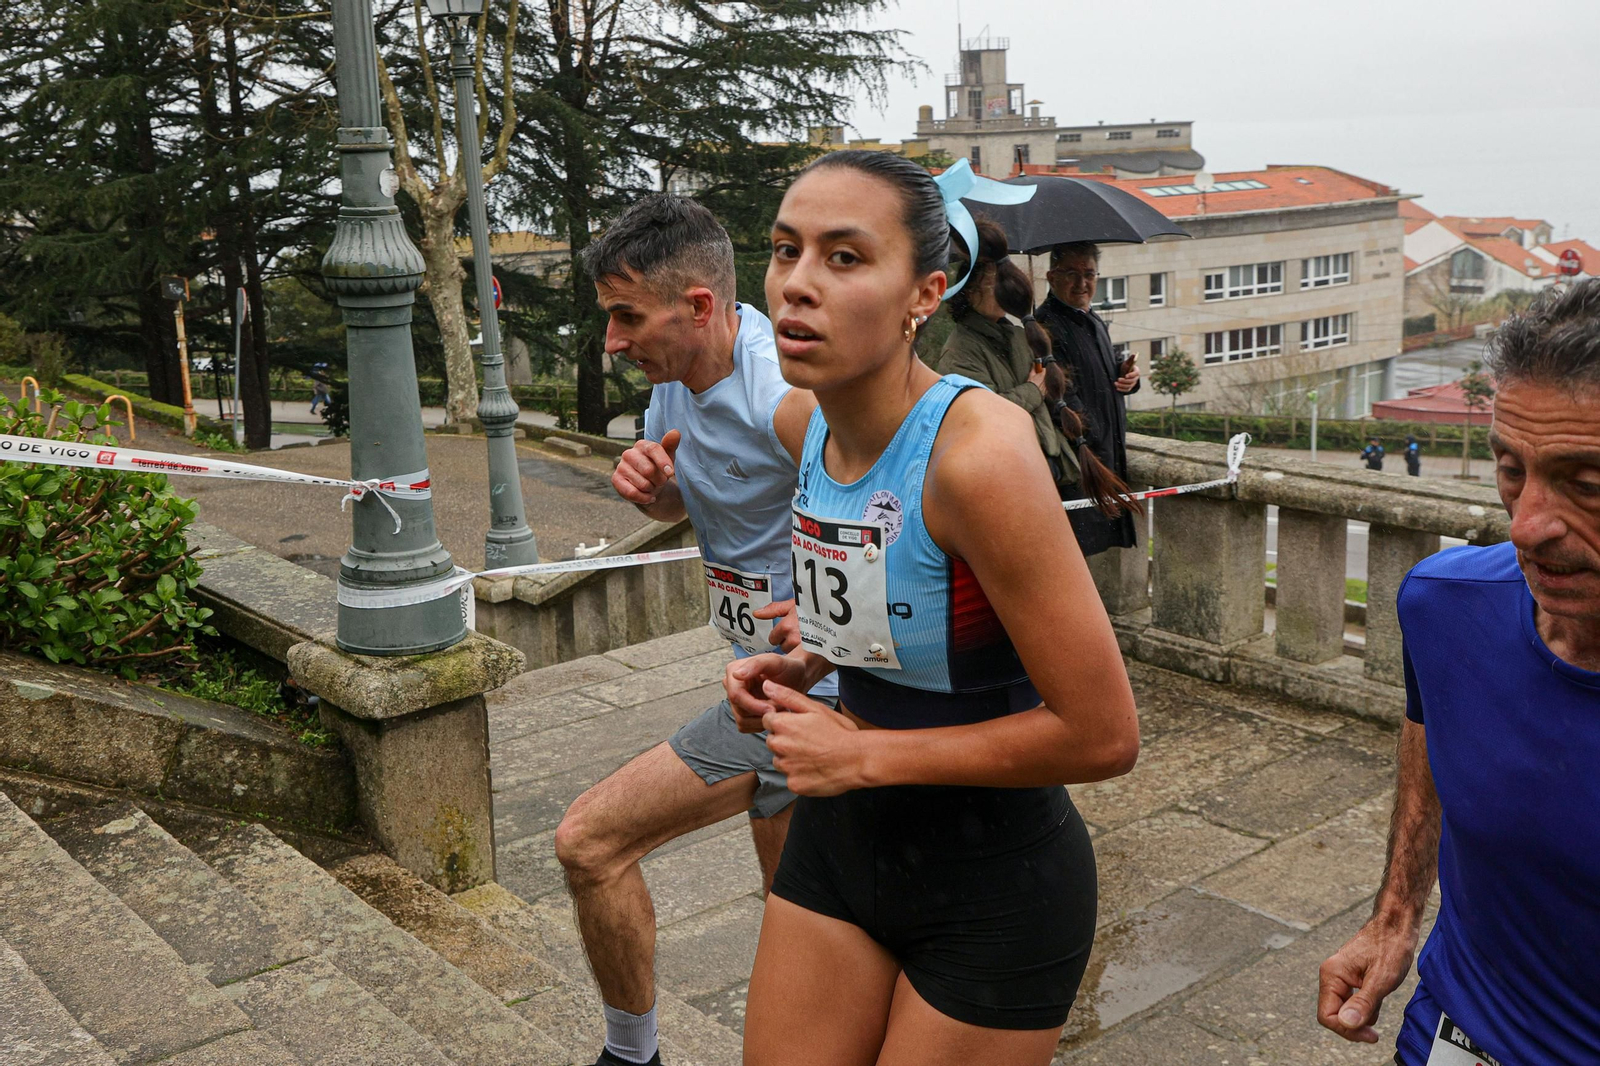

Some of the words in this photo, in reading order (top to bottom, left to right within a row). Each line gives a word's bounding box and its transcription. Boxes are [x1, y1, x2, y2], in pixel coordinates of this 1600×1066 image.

[18, 443, 41, 453] DE
[49, 446, 90, 459] VIGO
[138, 460, 164, 469] terreo
[180, 464, 202, 473] xogo
[803, 539, 812, 551] AO
[814, 543, 847, 562] CASTRO
[726, 585, 749, 598] CASTRO
[719, 596, 755, 636] 46
